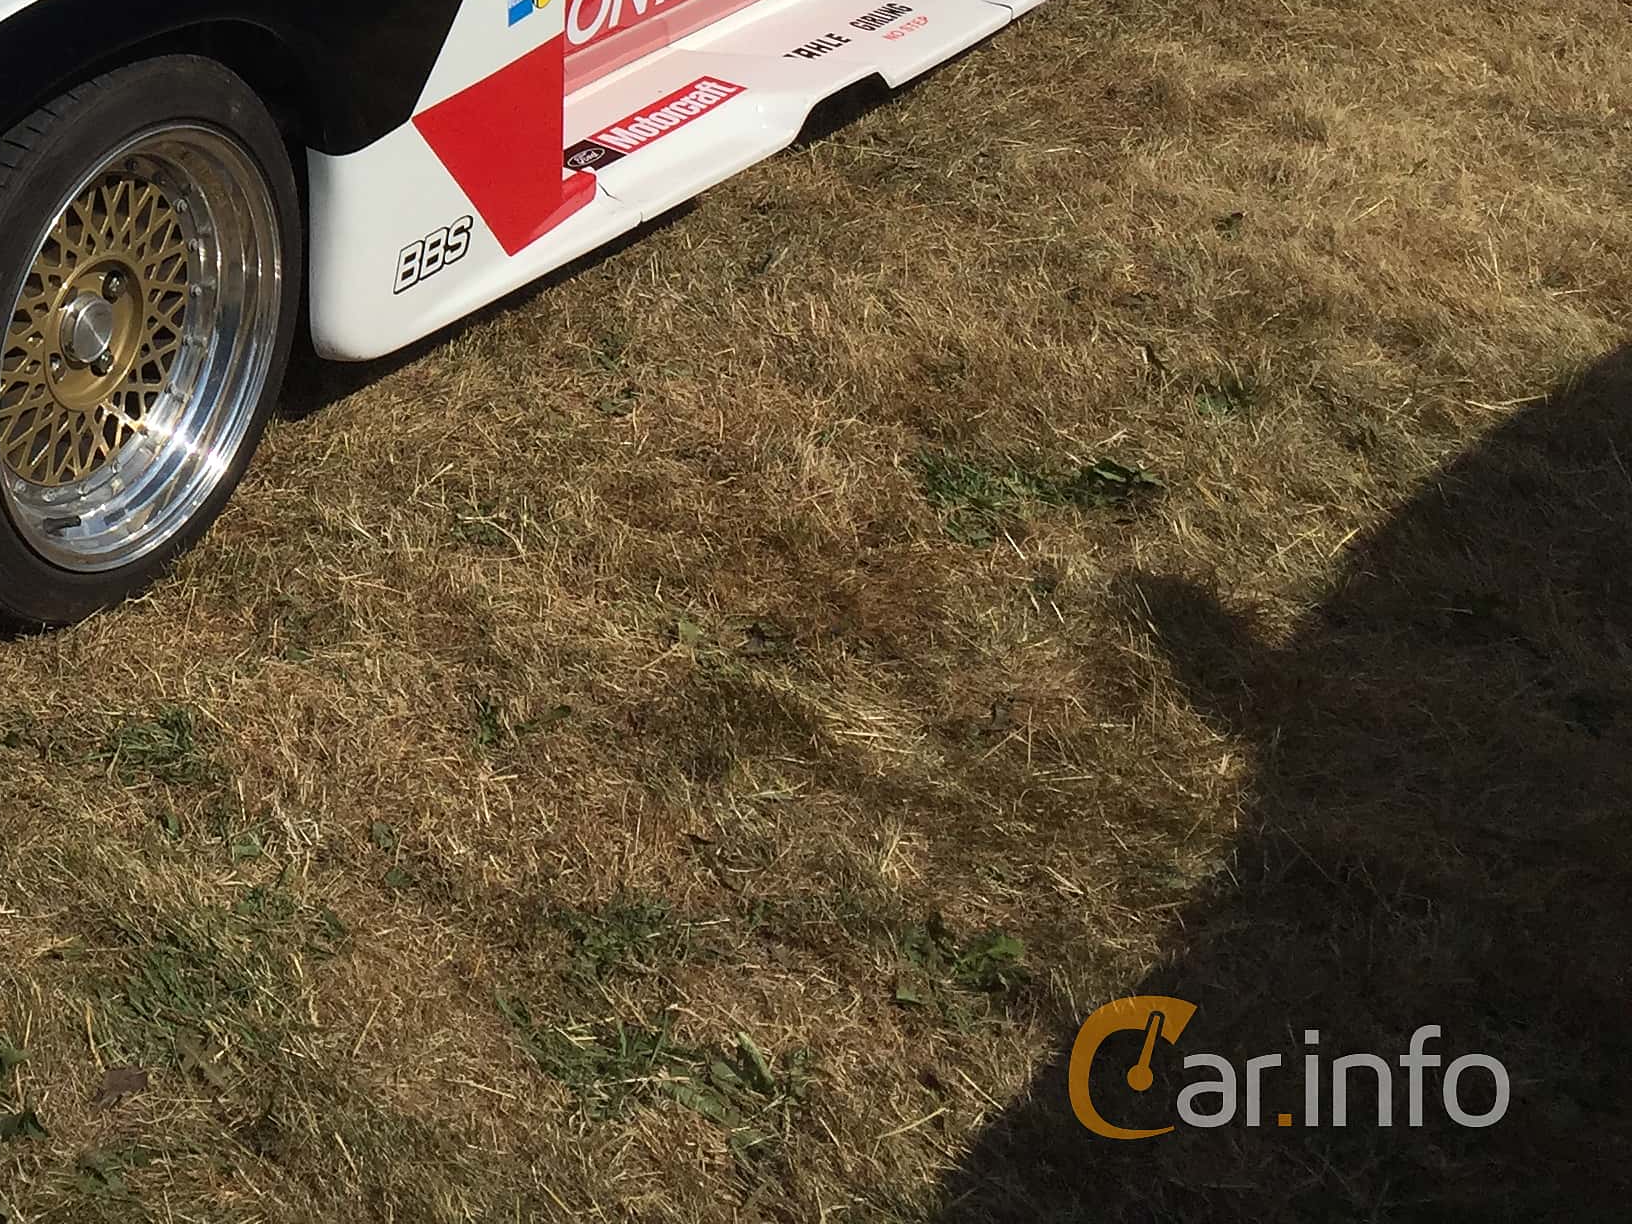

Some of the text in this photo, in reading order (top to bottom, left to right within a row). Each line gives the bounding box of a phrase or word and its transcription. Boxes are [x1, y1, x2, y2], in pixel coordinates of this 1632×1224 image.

[849, 2, 913, 32] GIRLING
[597, 80, 739, 150] Motorcraft
[571, 149, 602, 166] Ford
[393, 215, 474, 294] BBS
